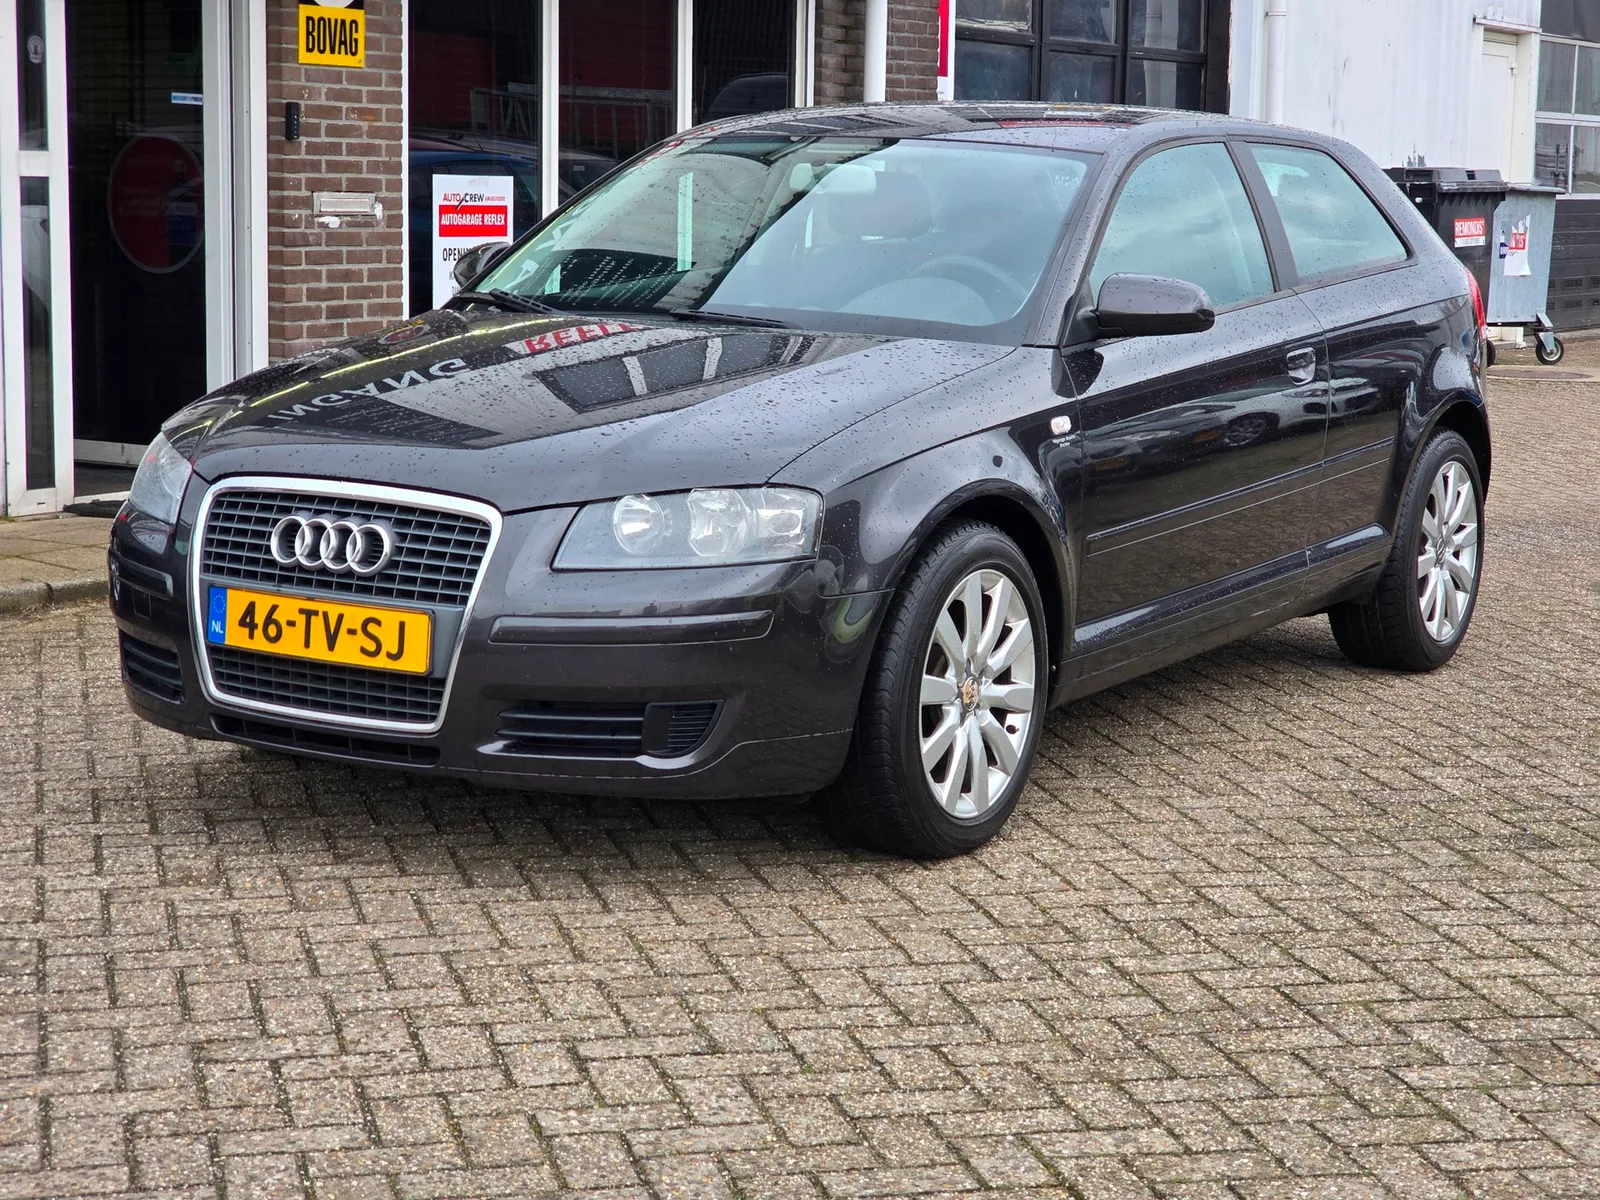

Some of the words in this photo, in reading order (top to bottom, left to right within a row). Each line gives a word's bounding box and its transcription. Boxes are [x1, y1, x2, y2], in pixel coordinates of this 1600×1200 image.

[305, 15, 359, 57] BOVAG
[443, 193, 461, 203] AUTO
[464, 192, 485, 203] CREW
[441, 213, 483, 226] AUTOGARAGE
[483, 213, 506, 226] REFLEX
[211, 620, 224, 634] NL
[238, 600, 406, 662] 46-TV-SJ
